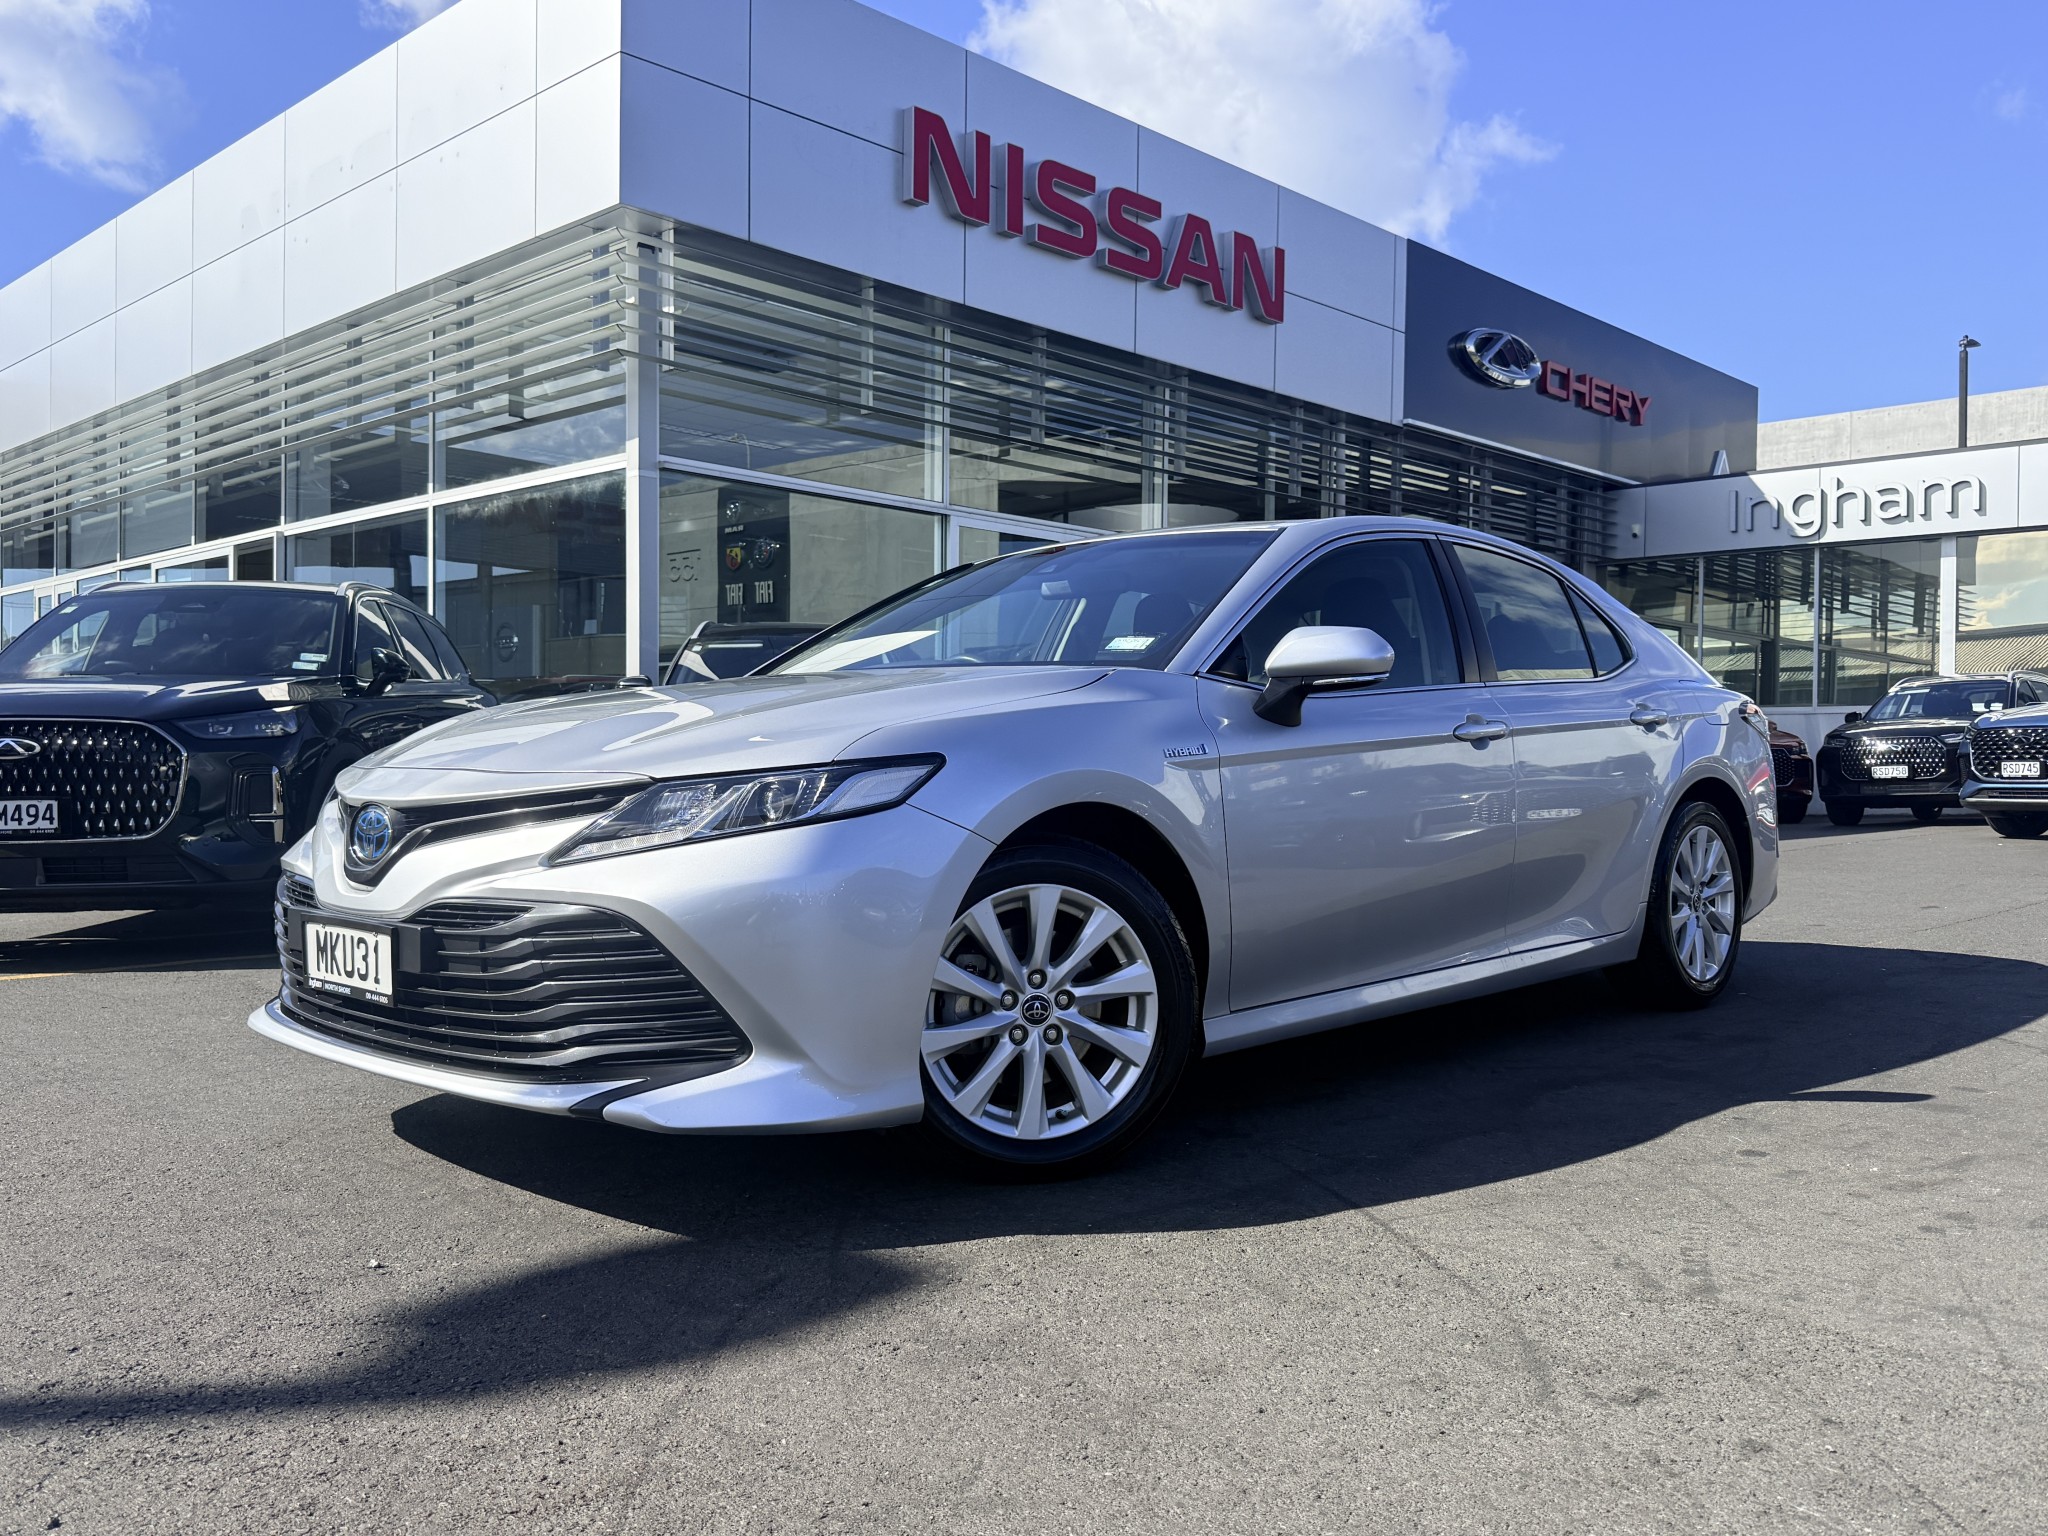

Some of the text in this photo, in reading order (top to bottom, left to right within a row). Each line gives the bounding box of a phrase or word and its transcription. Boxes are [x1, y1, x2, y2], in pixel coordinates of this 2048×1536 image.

[904, 106, 1285, 325] NISSAN
[1541, 360, 1652, 426] CHERY
[1728, 474, 1982, 537] Ingham
[1163, 744, 1205, 759] HYBRID
[2003, 763, 2039, 774] RSD745
[1872, 767, 1907, 776] RSD758
[316, 929, 381, 984] MKU31
[324, 983, 339, 992] NORTH
[338, 986, 352, 995] SHORE
